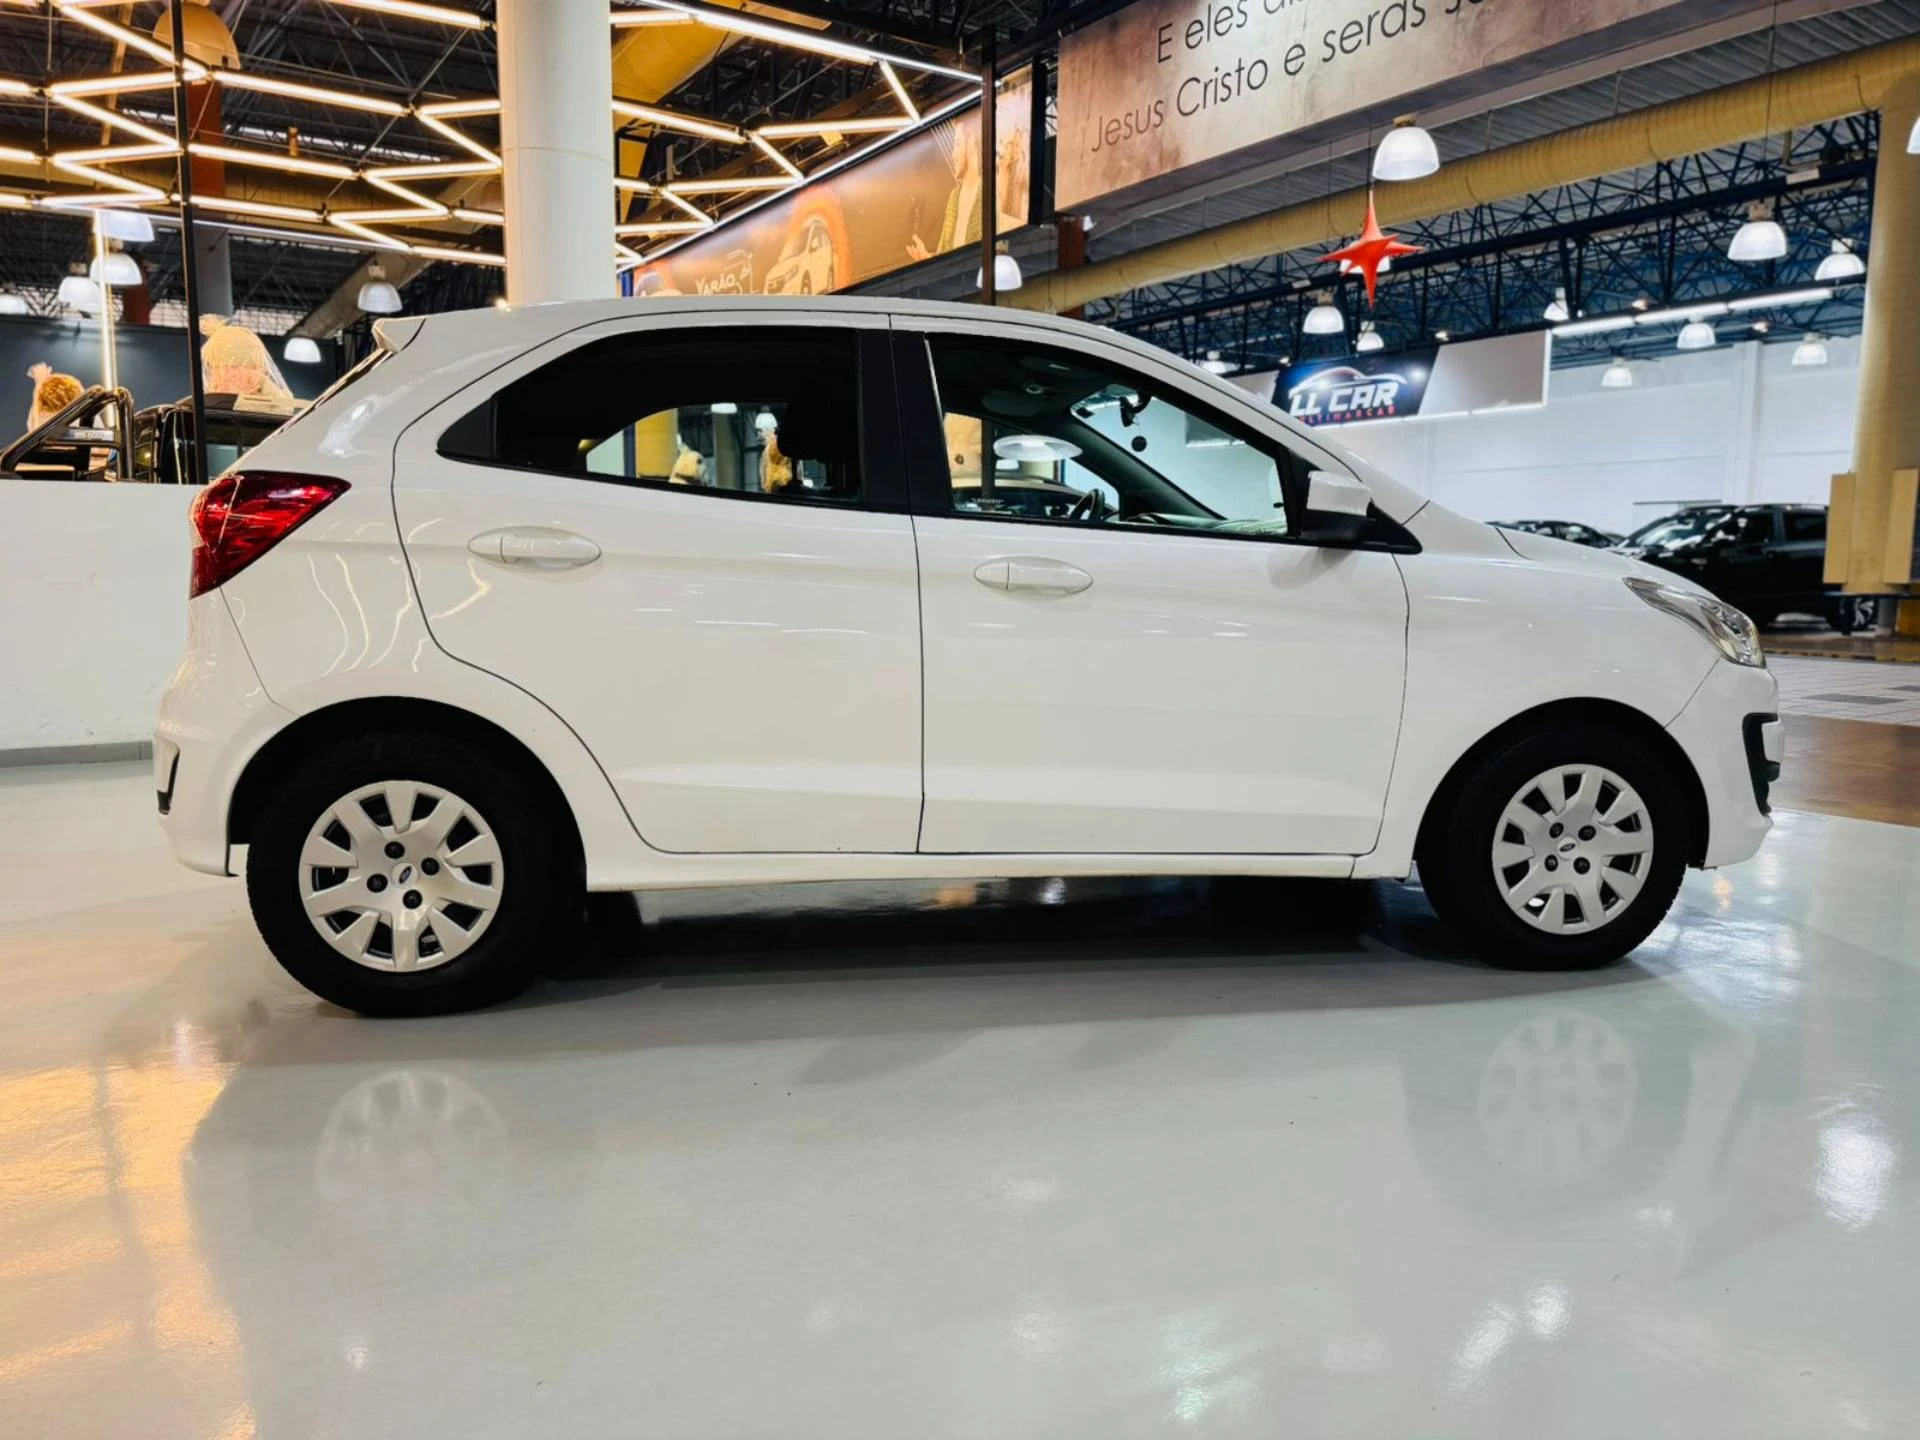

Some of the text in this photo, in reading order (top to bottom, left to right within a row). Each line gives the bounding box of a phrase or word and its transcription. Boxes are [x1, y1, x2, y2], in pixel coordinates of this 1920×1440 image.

[1158, 0, 1248, 63] E eles
[1092, 100, 1164, 152] Jesus
[1177, 58, 1268, 117] Cristo
[1284, 44, 1306, 76] e
[1328, 382, 1399, 412] CAR
